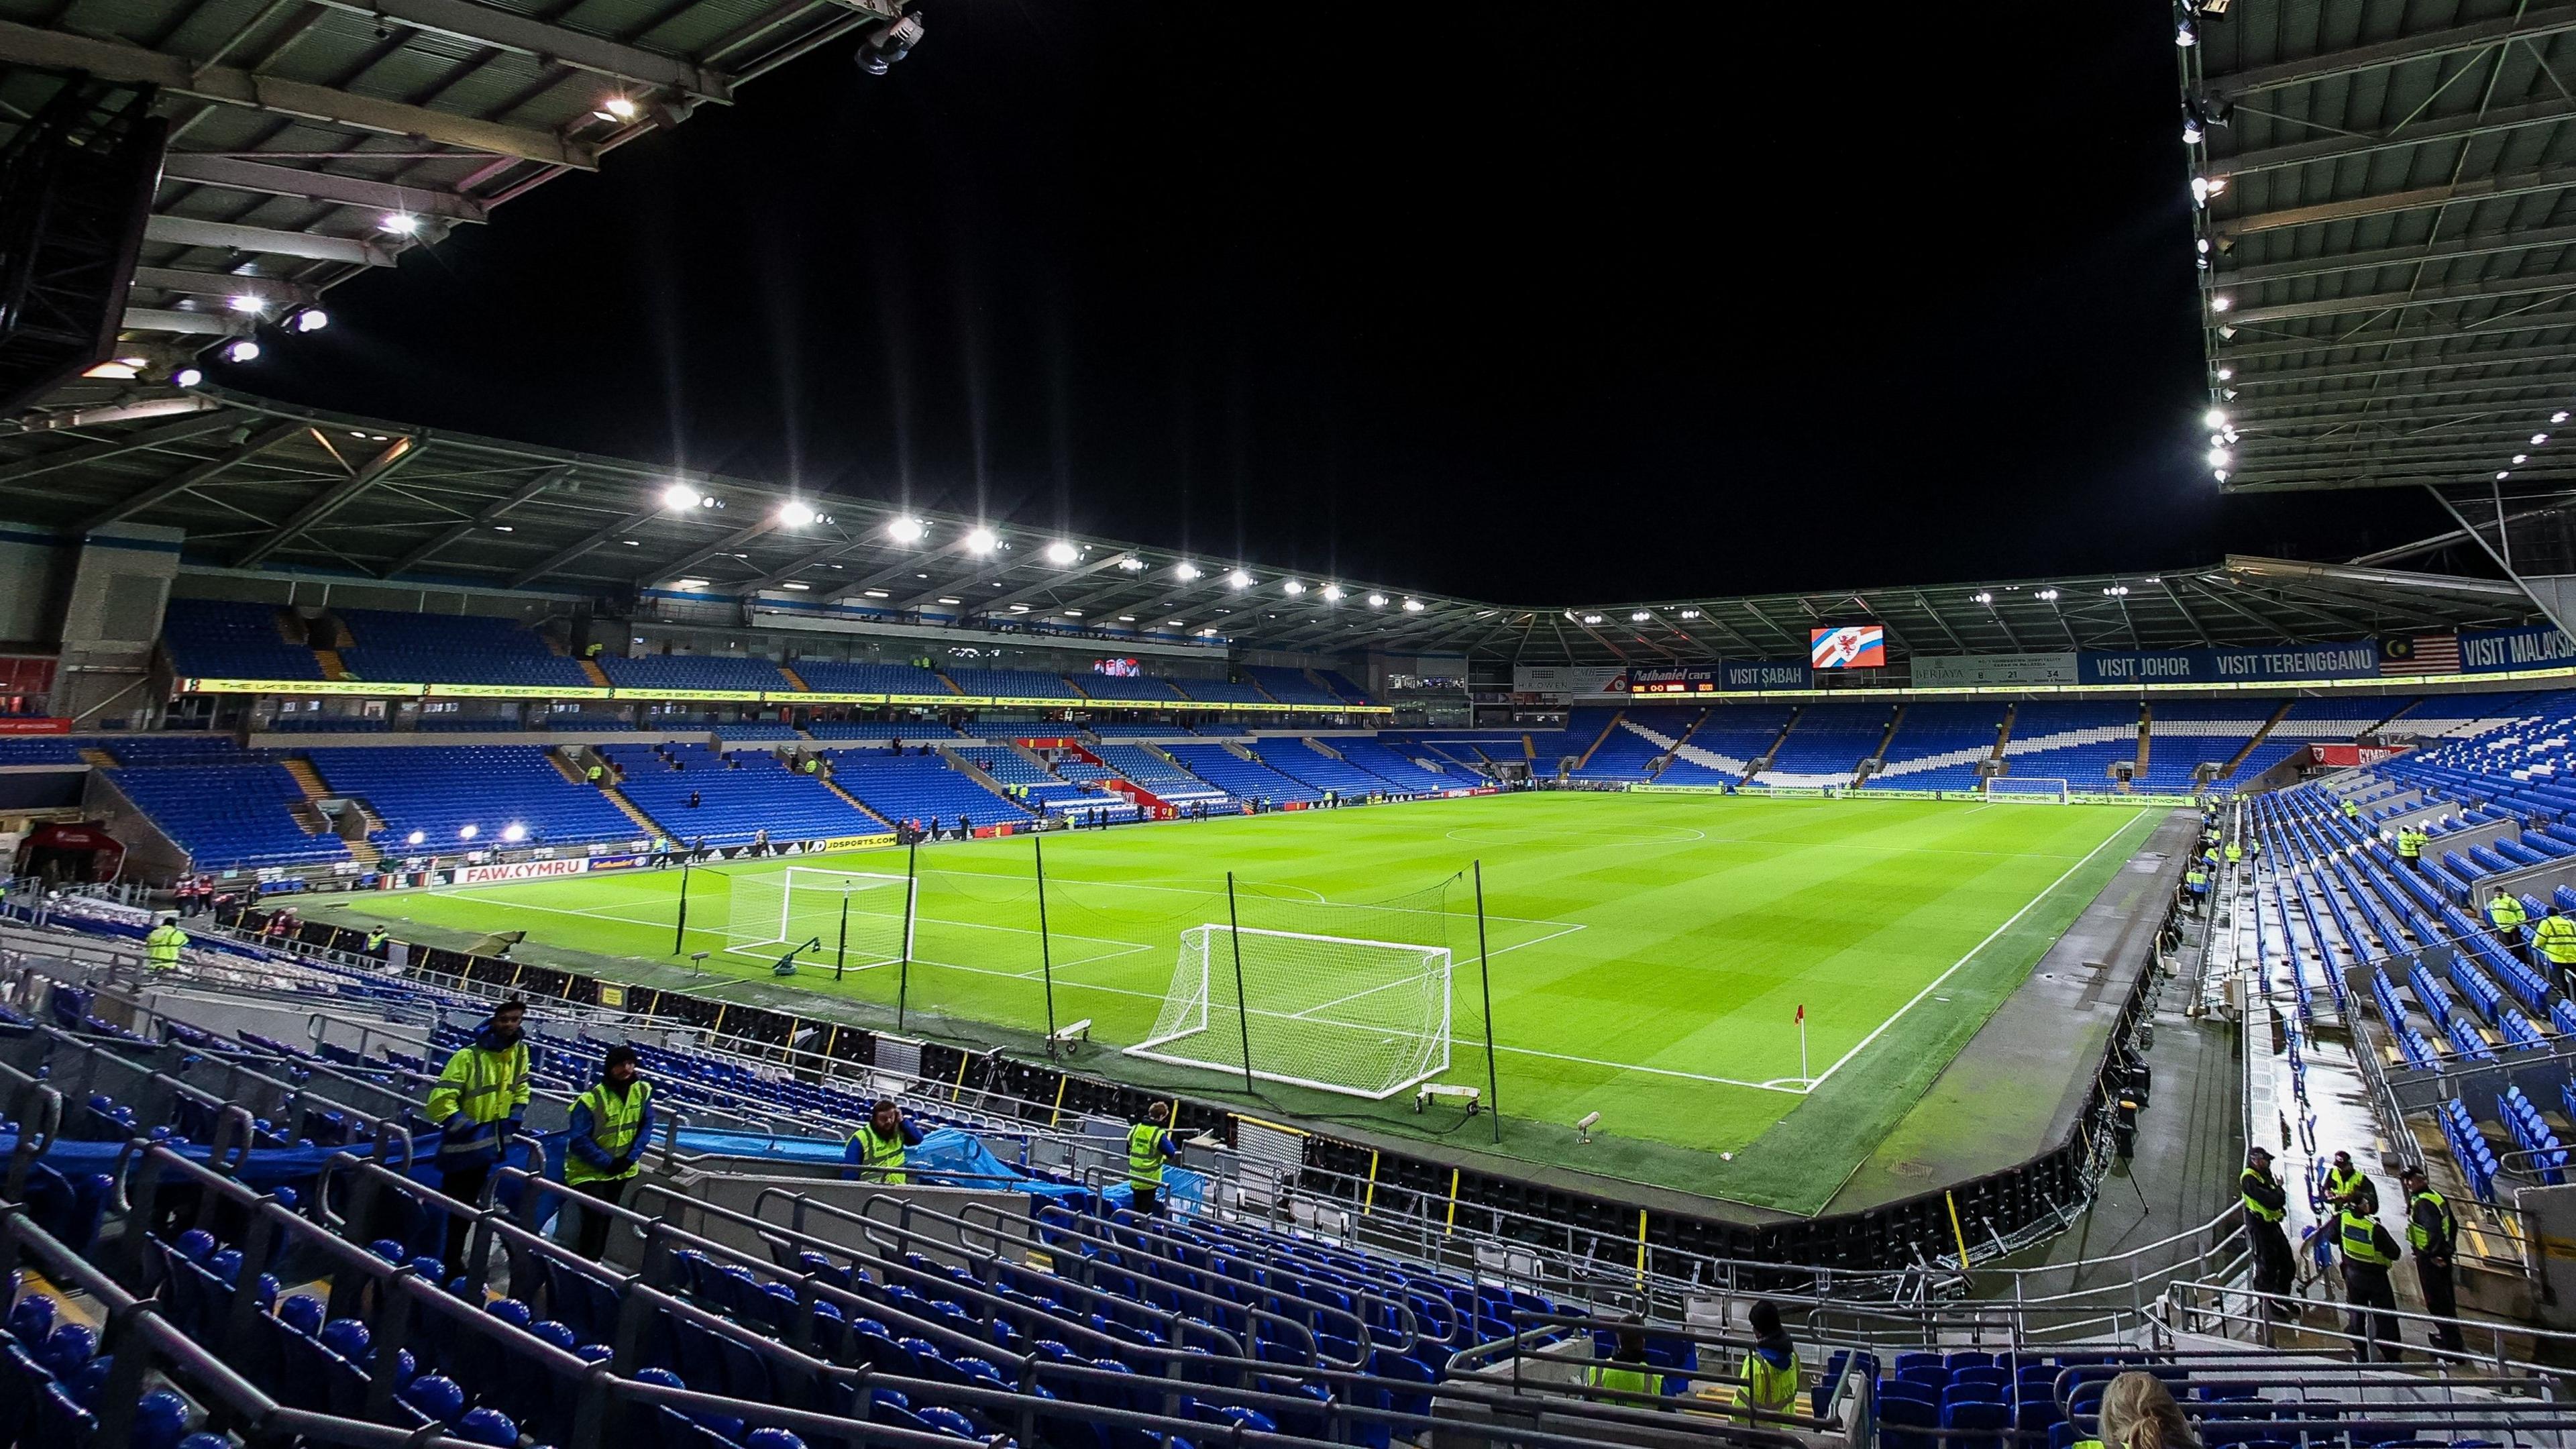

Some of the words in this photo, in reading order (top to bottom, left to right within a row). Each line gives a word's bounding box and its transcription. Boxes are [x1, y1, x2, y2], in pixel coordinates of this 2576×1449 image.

[2464, 637, 2505, 666] VISIT
[2096, 658, 2135, 677] VISIT
[2140, 657, 2190, 676] JOHOR
[2217, 655, 2258, 675] VISIT
[2262, 649, 2372, 673] TERENGGANU
[1633, 668, 1688, 682] Nathaniel
[1688, 672, 1711, 680] cars
[1729, 668, 1758, 684] VISIT
[219, 682, 251, 690] THE
[828, 837, 896, 849] JDSPORTS.COM
[466, 861, 580, 883] FAW.CYMRU
